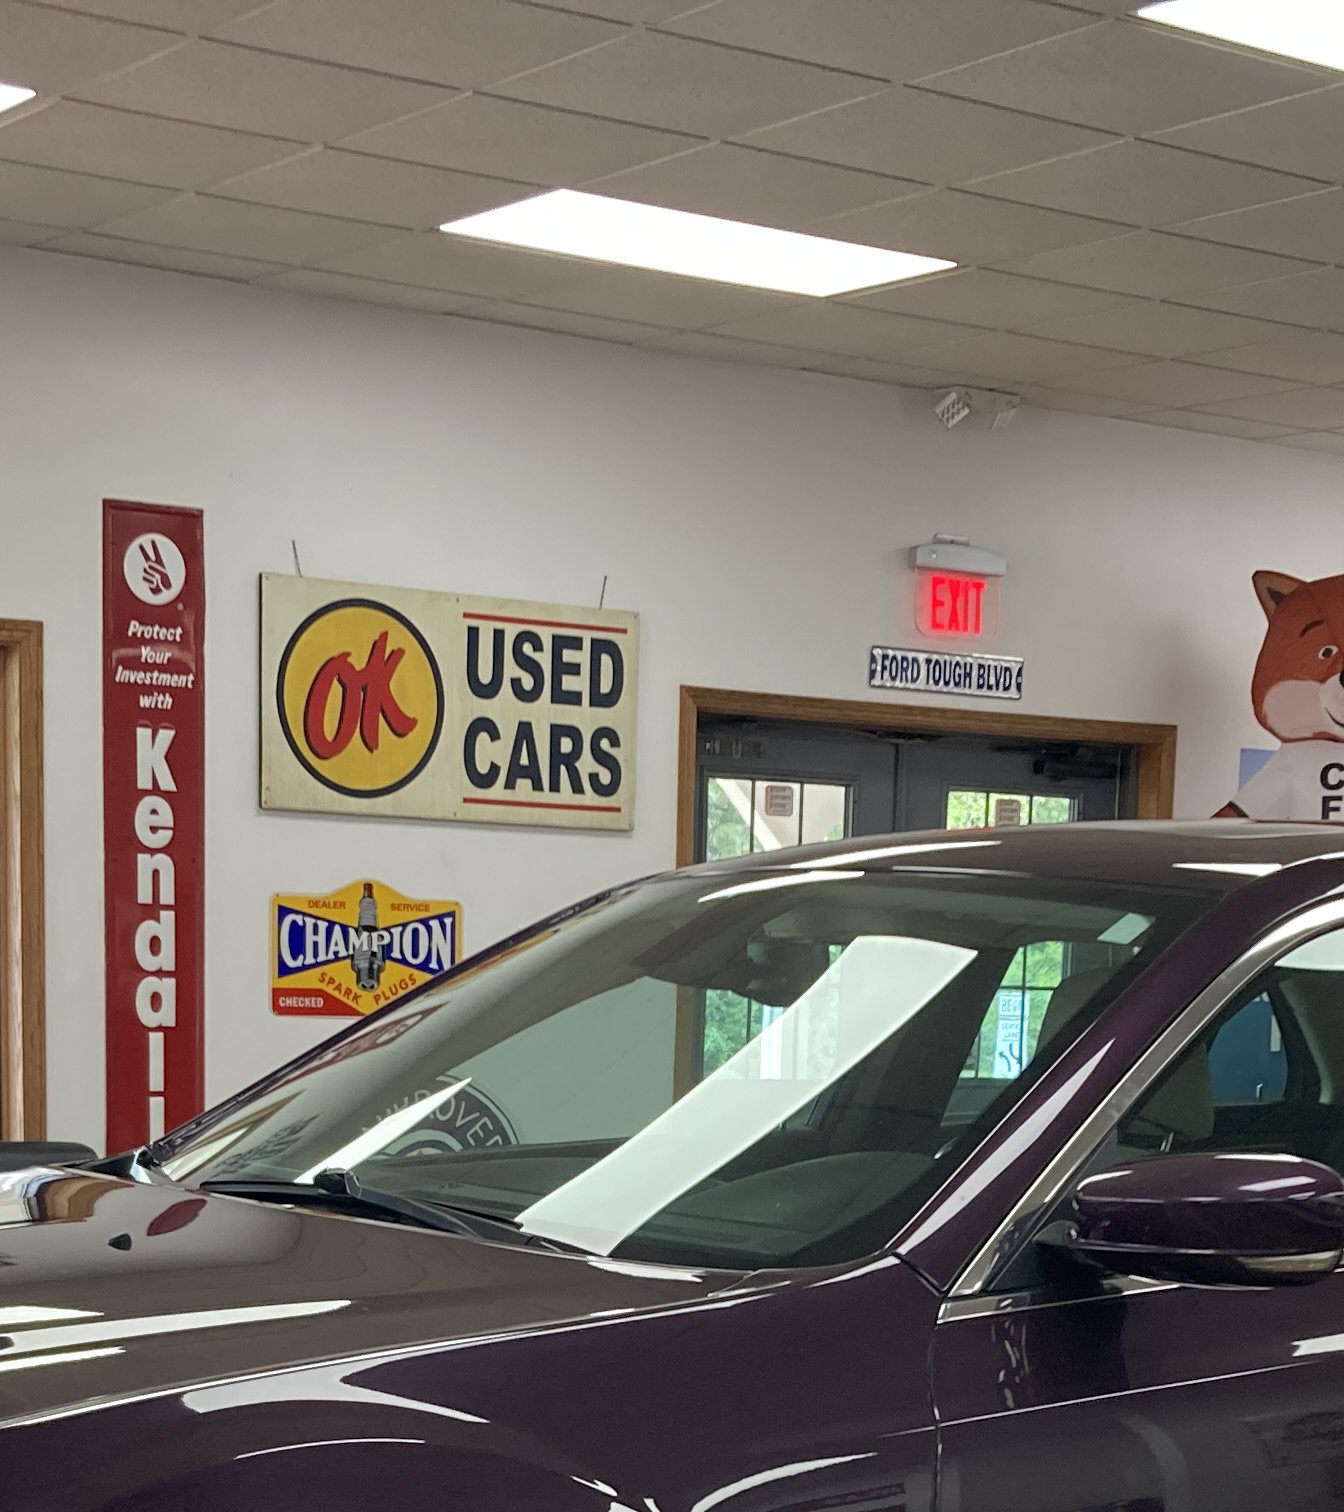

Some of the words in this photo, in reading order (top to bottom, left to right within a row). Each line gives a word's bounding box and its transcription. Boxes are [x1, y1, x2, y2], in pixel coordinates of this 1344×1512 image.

[930, 575, 987, 636] EXIT
[127, 619, 183, 642] Protect
[139, 645, 173, 665] Your
[465, 625, 624, 709] USED
[880, 653, 921, 684] FORD
[924, 658, 974, 689] TOUGH
[976, 663, 1013, 692] BLVD
[114, 664, 195, 689] Investment
[302, 630, 418, 760] OK
[138, 691, 174, 710] with
[462, 716, 623, 798] CARS
[307, 899, 347, 910] DEALER
[390, 902, 431, 913] SERVICE
[133, 726, 178, 1150] Kendall
[279, 912, 454, 972] CHAMPION
[278, 996, 324, 1009] CHECKED
[318, 971, 361, 1006] SPARK
[373, 973, 418, 1006] PLUGS
